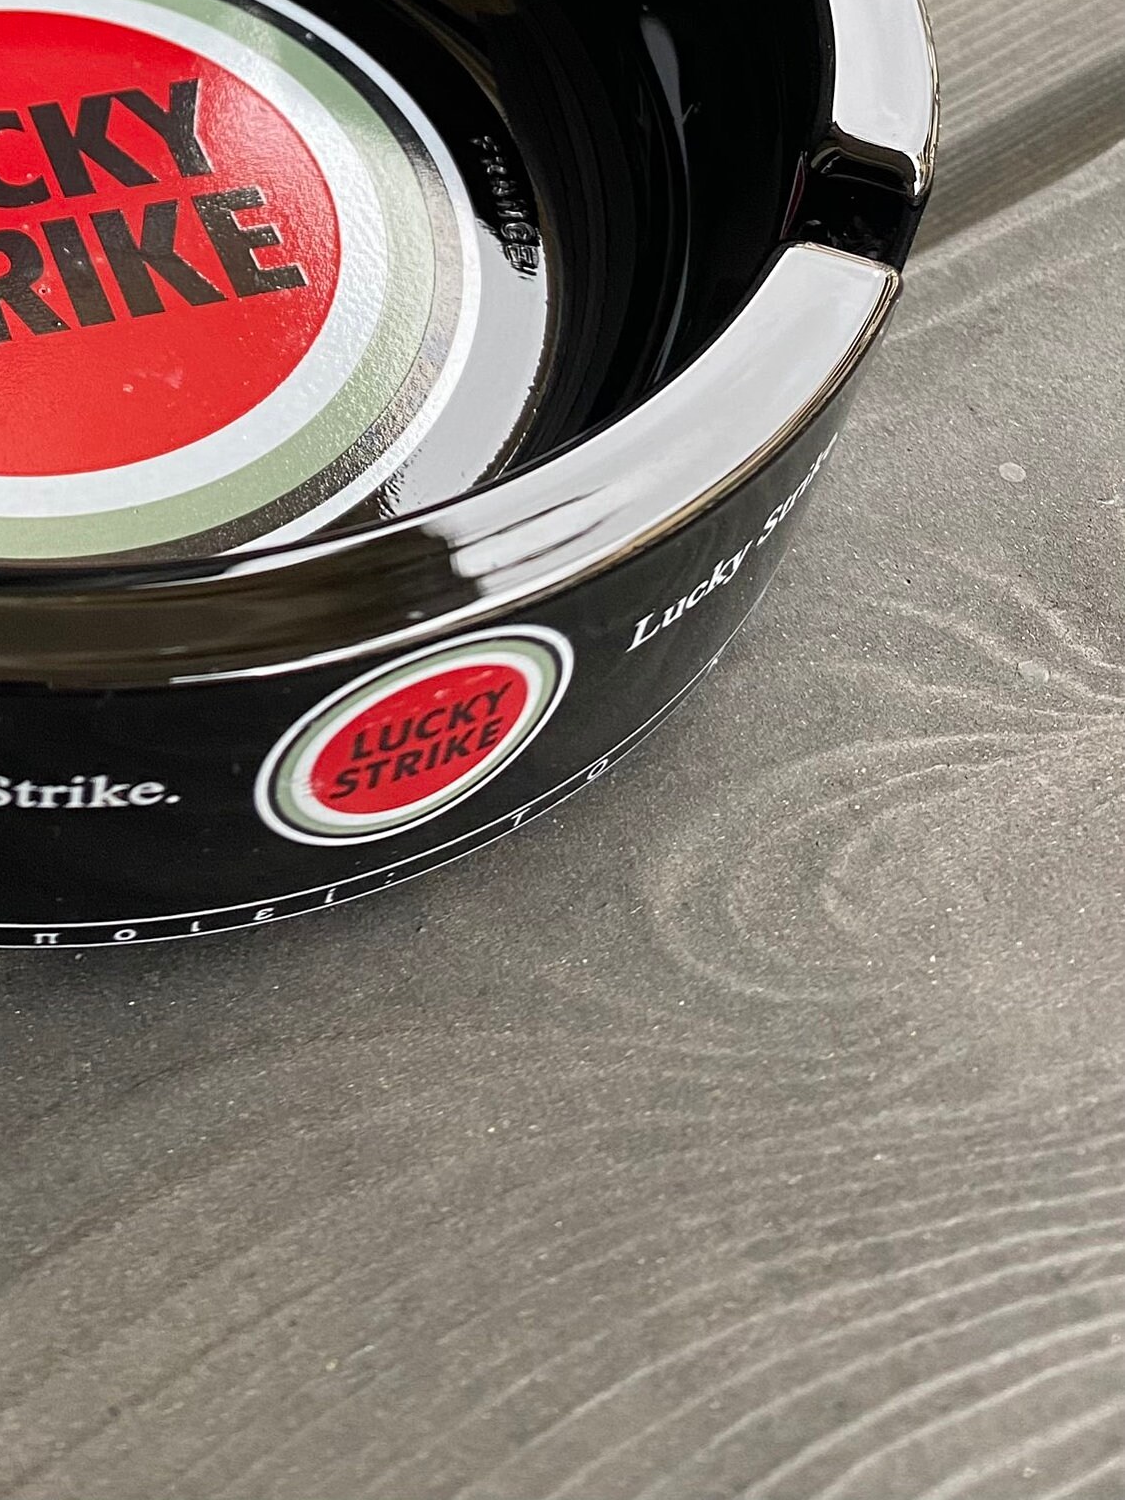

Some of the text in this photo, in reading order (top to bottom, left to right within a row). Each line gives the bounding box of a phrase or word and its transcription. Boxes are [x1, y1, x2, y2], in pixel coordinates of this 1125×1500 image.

[626, 540, 753, 652] Lucky
[329, 716, 502, 799] STRIKE
[350, 681, 512, 761] LUCKY
